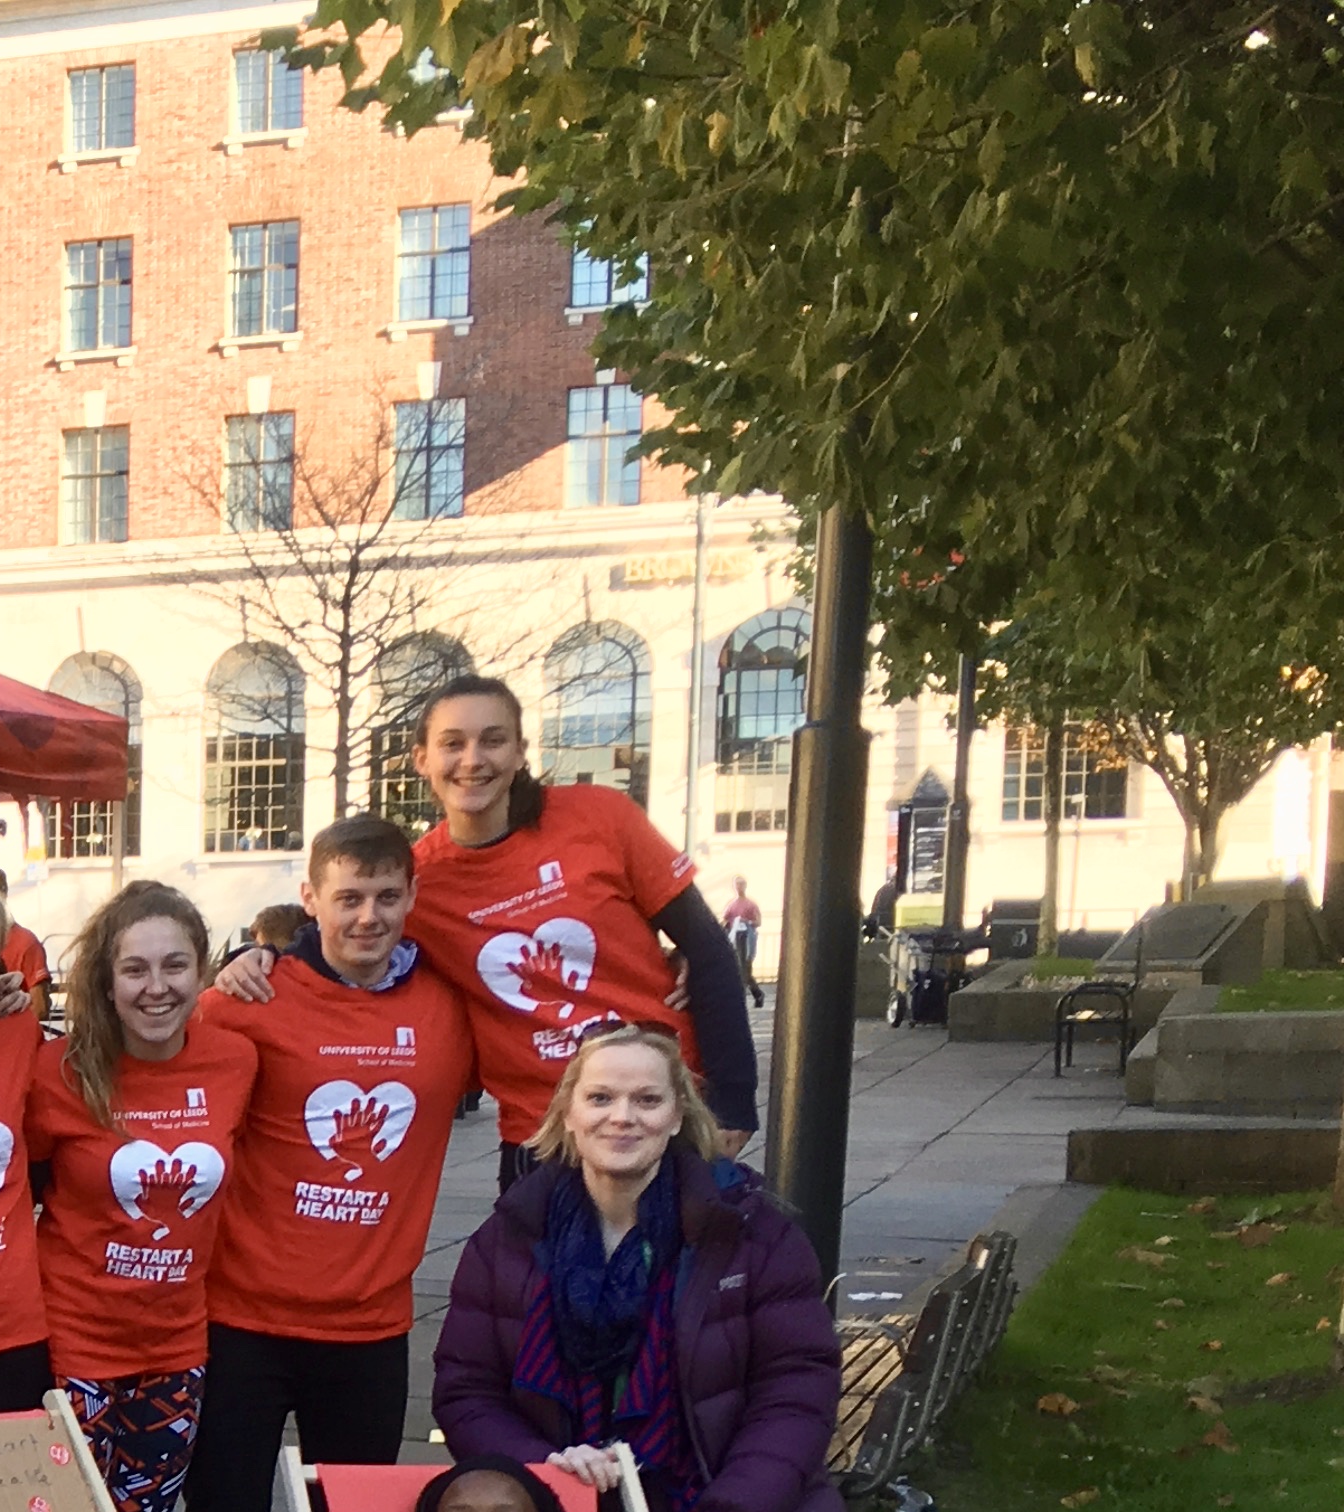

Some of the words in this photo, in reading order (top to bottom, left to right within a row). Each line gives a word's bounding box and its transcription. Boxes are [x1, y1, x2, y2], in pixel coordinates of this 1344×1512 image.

[319, 1046, 378, 1056] UNIVERSITY
[378, 1046, 390, 1056] OF
[391, 1047, 417, 1057] LEEDS
[183, 1107, 208, 1118] LEEDS
[295, 1181, 378, 1207] RESTART
[378, 1191, 390, 1208] A
[295, 1199, 360, 1223] HEART
[360, 1208, 384, 1220] DAY
[105, 1241, 183, 1265] RESTART
[181, 1248, 193, 1264] A
[106, 1259, 168, 1282] HEART
[167, 1264, 188, 1278] DAY
